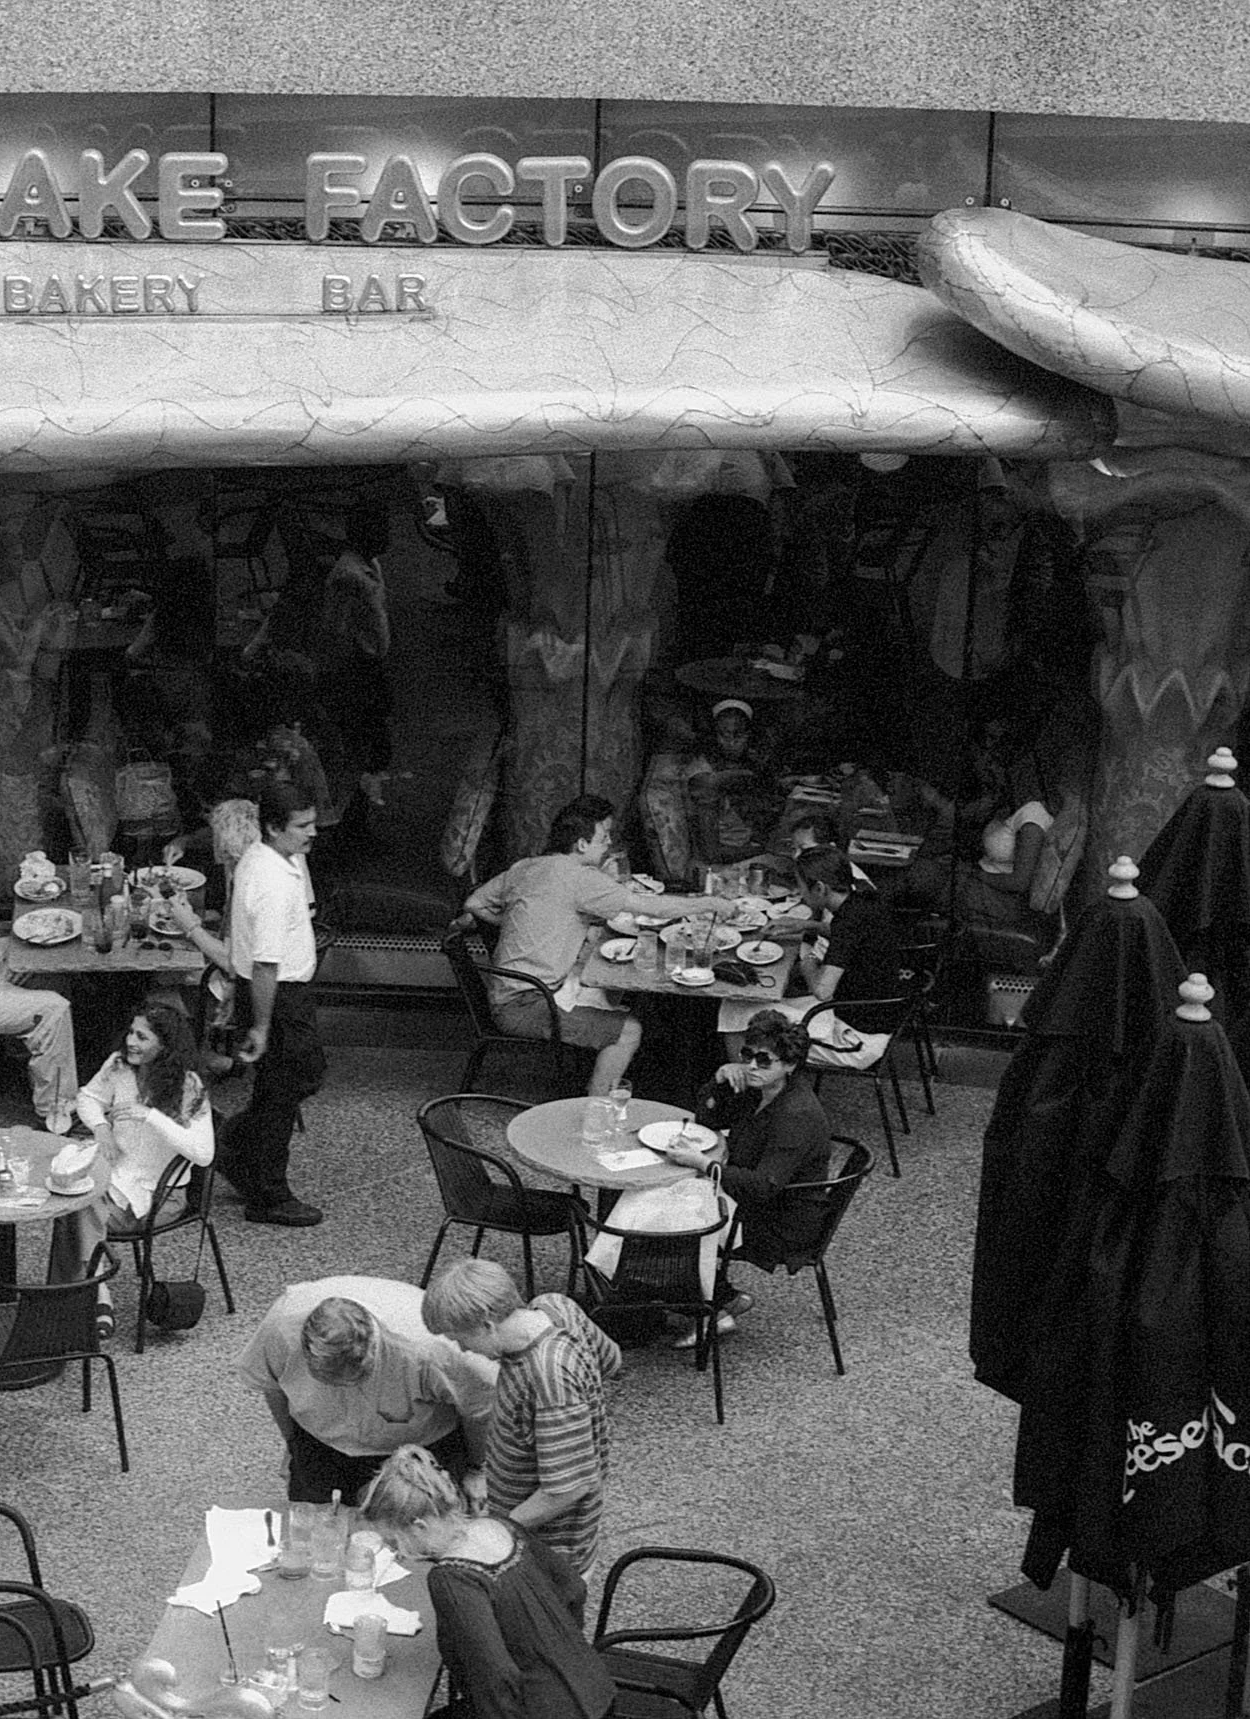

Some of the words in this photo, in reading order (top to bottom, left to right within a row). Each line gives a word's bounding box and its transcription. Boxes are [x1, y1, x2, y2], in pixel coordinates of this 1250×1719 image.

[305, 150, 836, 253] FACTORY
[4, 274, 204, 314] BAKERY
[322, 273, 428, 313] BAR
